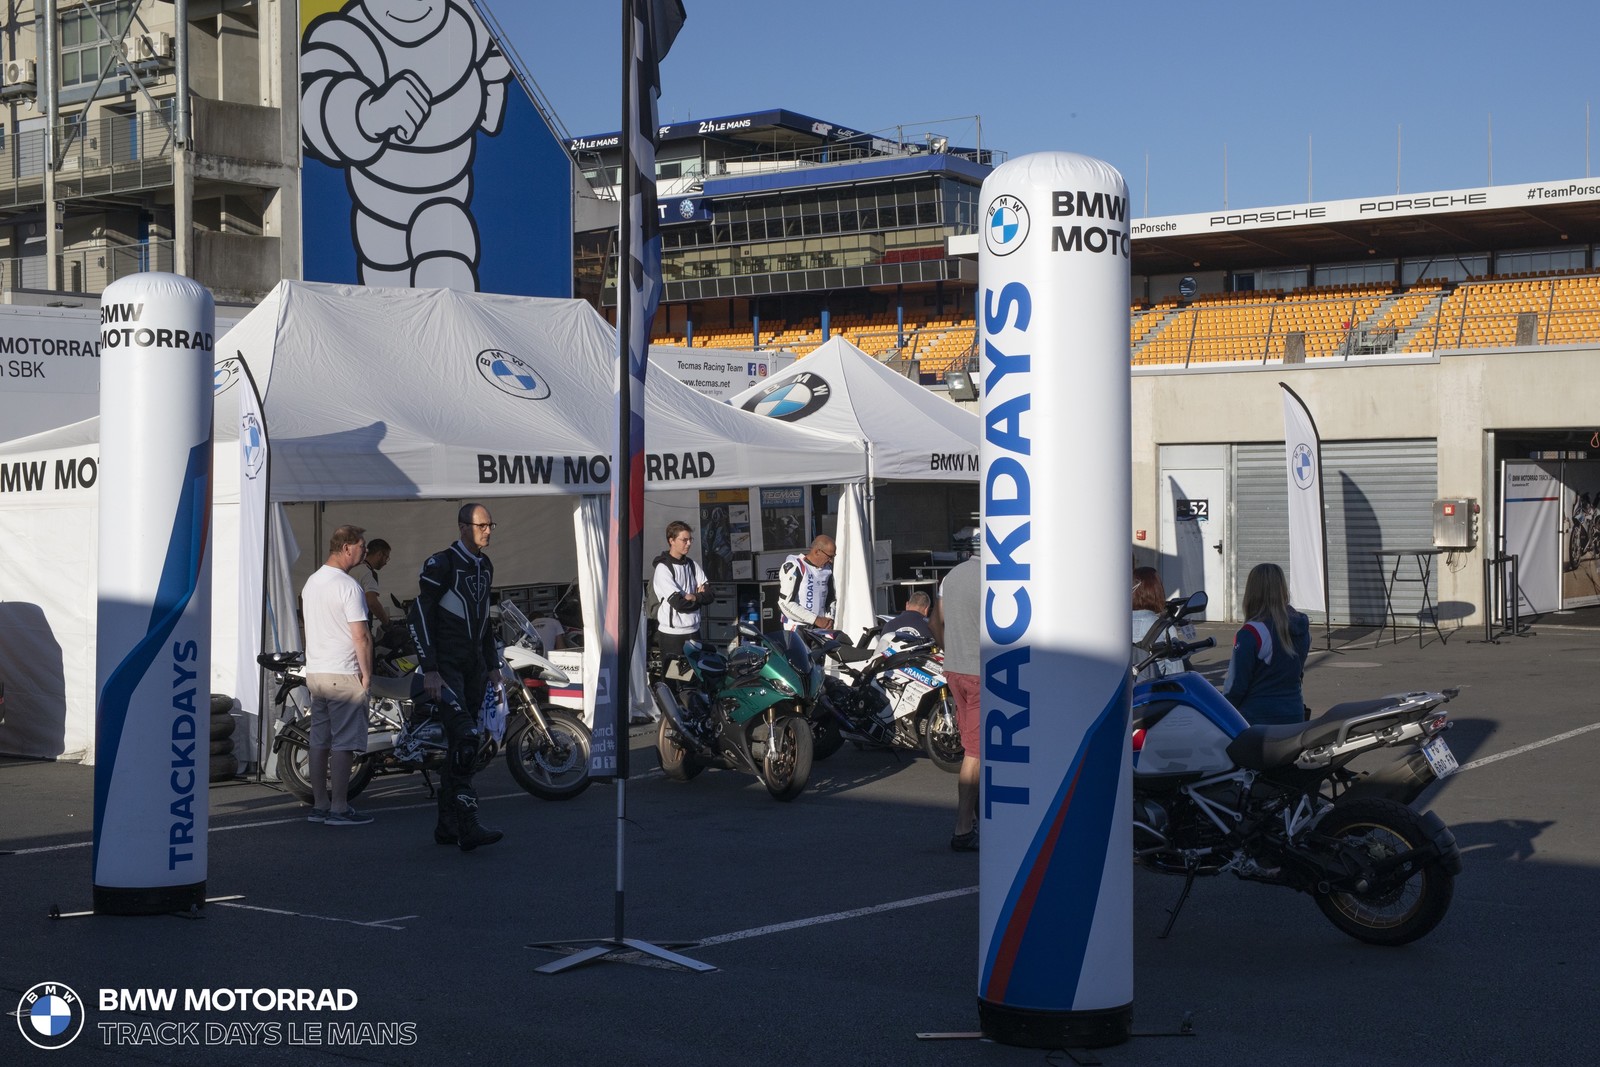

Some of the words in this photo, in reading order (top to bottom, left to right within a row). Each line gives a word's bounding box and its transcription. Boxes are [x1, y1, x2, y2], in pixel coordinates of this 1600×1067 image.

[715, 123, 725, 131] LE
[726, 119, 751, 129] MANS
[596, 137, 619, 147] MANS
[1527, 184, 1600, 200] #TeamPorsc
[1052, 191, 1126, 223] BMW
[1360, 192, 1487, 214] PORSCHE
[1210, 207, 1326, 227] PORSCHE
[1131, 221, 1177, 234] mPorsche
[1051, 226, 1130, 259] MOTO
[8, 360, 46, 379] SBK
[677, 360, 702, 370] Tecmas
[703, 362, 725, 373] Racing
[727, 363, 744, 372] Team
[477, 453, 554, 485] BMW
[563, 451, 716, 485] MORRAD
[930, 453, 965, 471] BMW
[0, 460, 47, 493] MW
[1189, 501, 1207, 516] 52
[984, 281, 1032, 820] TRACKDAYS
[806, 573, 814, 611] CKDAYS
[903, 667, 931, 685] FRANCE
[168, 639, 198, 871] TRACKDAYS
